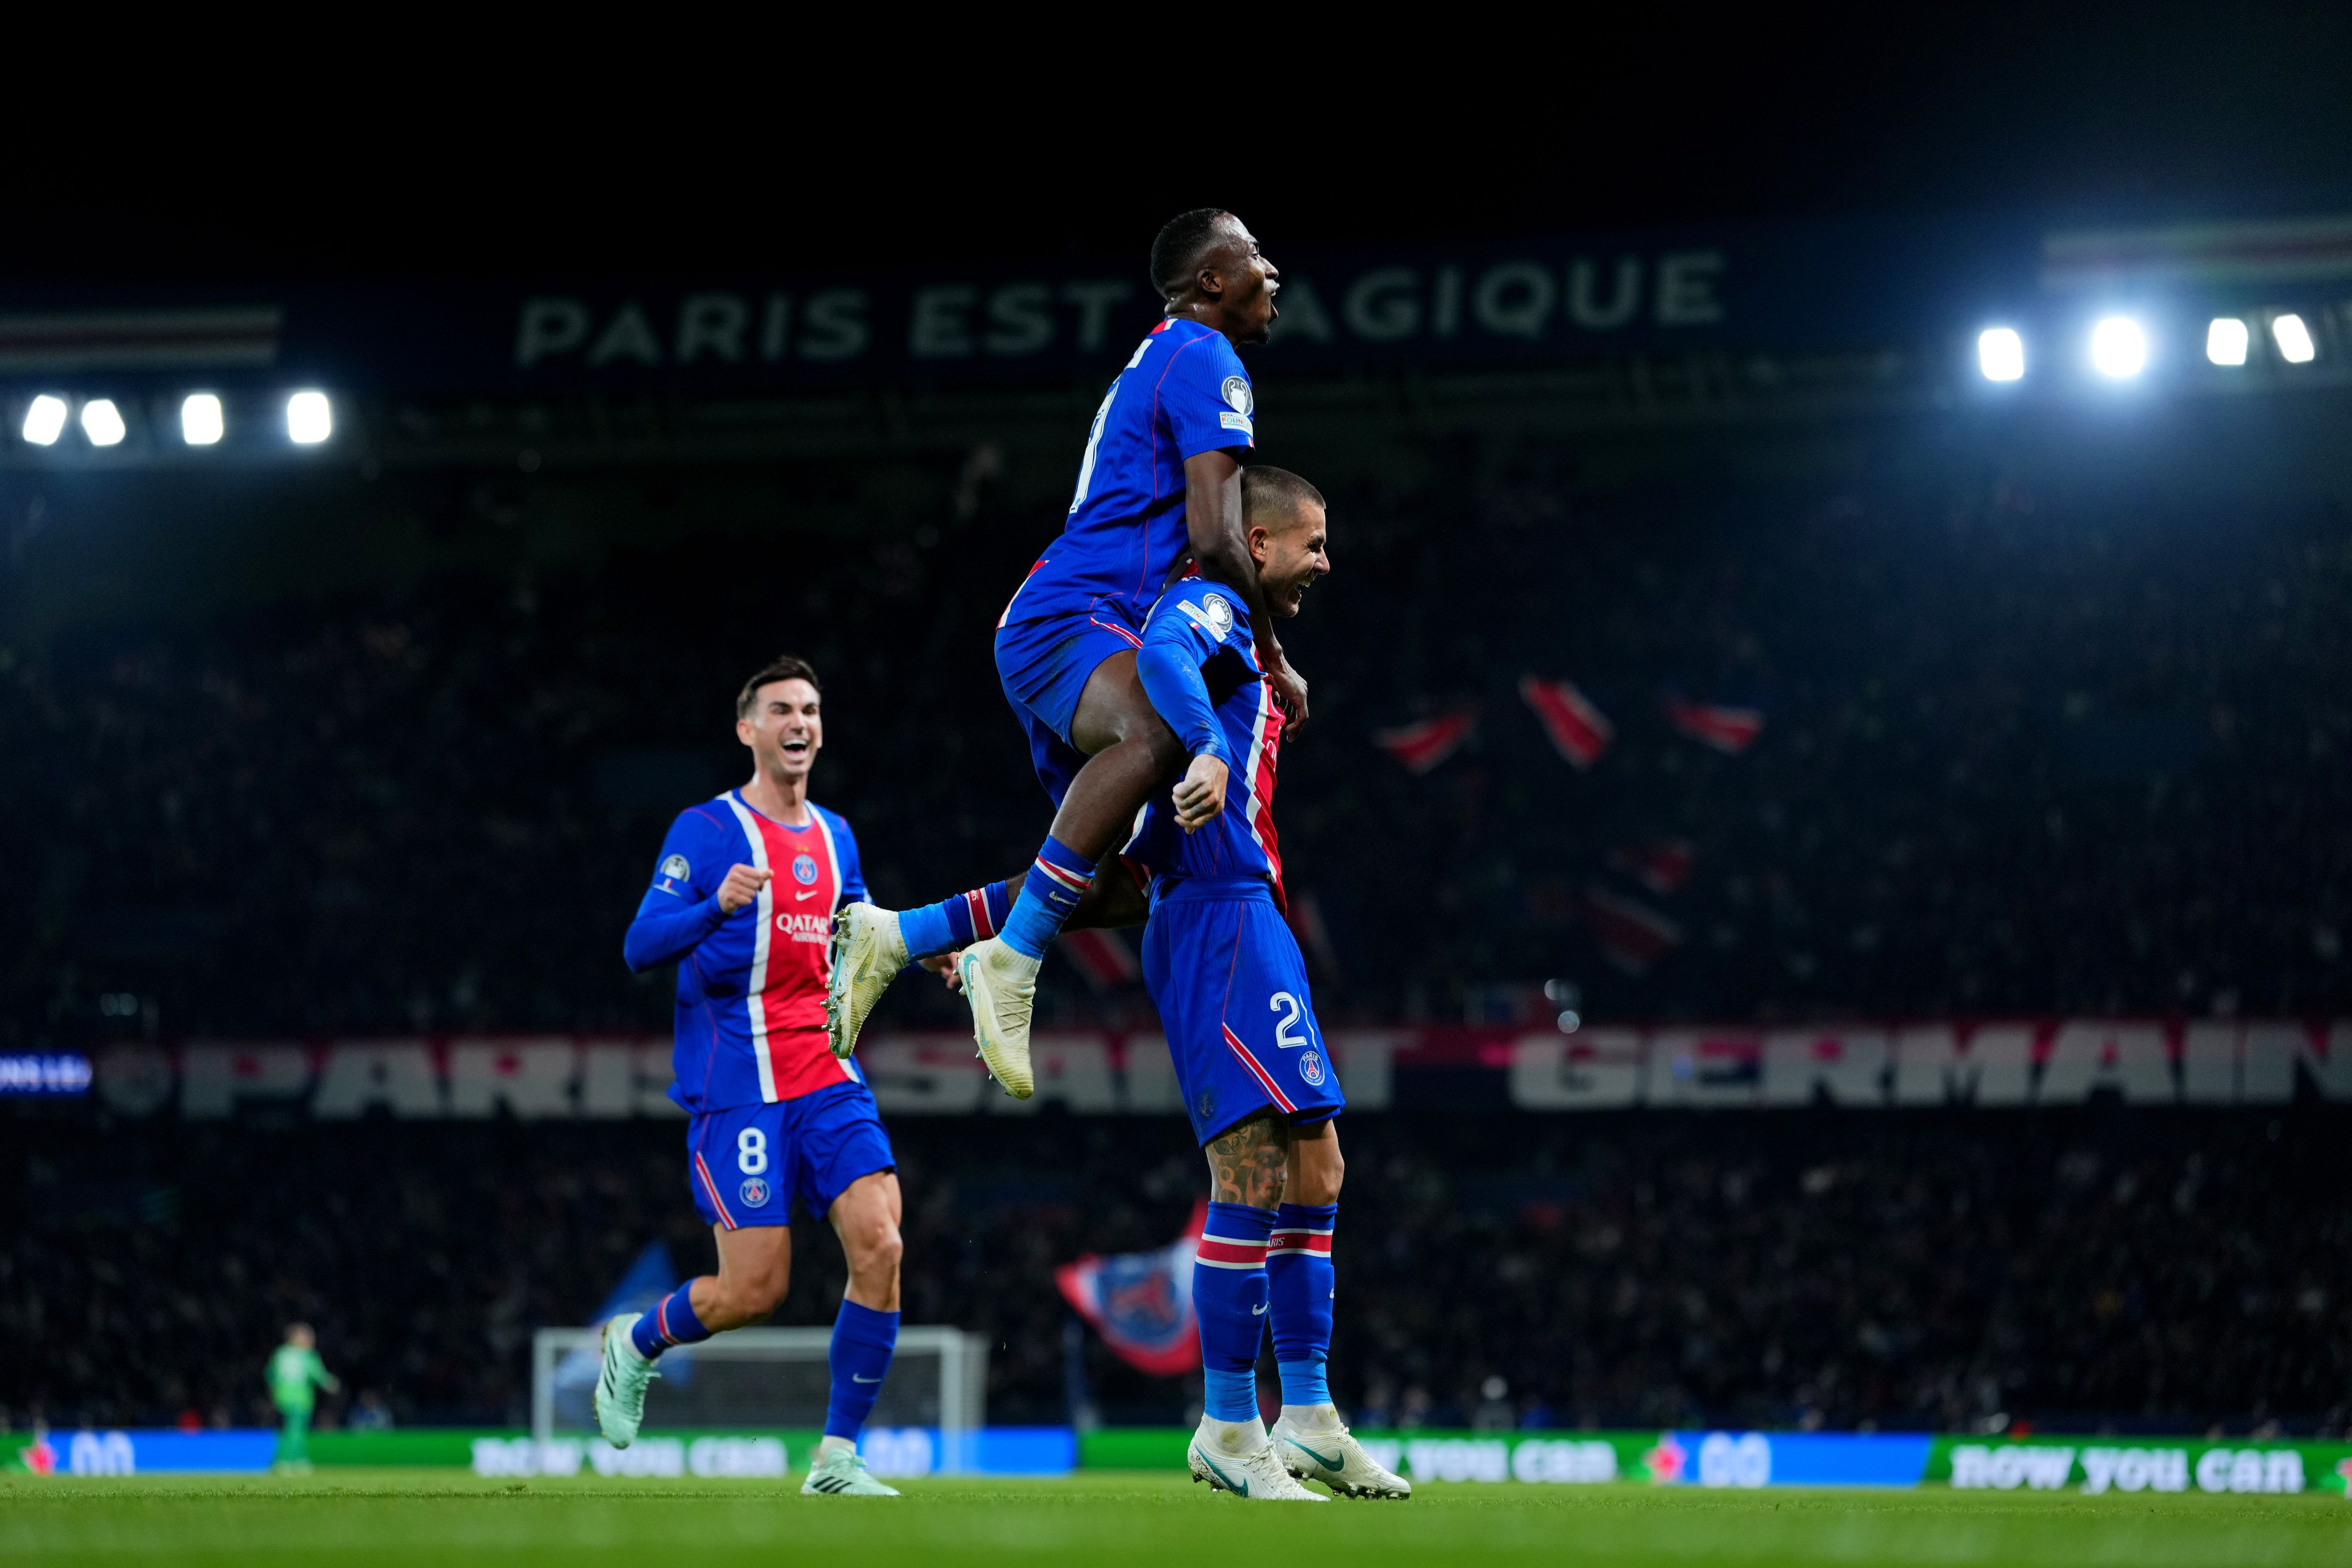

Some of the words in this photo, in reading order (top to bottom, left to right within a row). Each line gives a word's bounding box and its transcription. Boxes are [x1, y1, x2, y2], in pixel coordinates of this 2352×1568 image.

[513, 288, 873, 368] PARIS
[907, 281, 1134, 358] EST
[1268, 248, 1728, 344] AGIQUE
[776, 912, 829, 935] QATAR
[1270, 991, 1317, 1049] 2
[852, 1032, 1422, 1115] SAIT
[1506, 1019, 2352, 1113] GERMAIN
[1302, 1053, 1318, 1062] PARIS
[737, 1127, 768, 1175] 8
[1268, 1237, 1285, 1248] RIS
[1951, 1445, 2075, 1490] now
[2080, 1448, 2188, 1495] you
[2196, 1448, 2305, 1493] can
